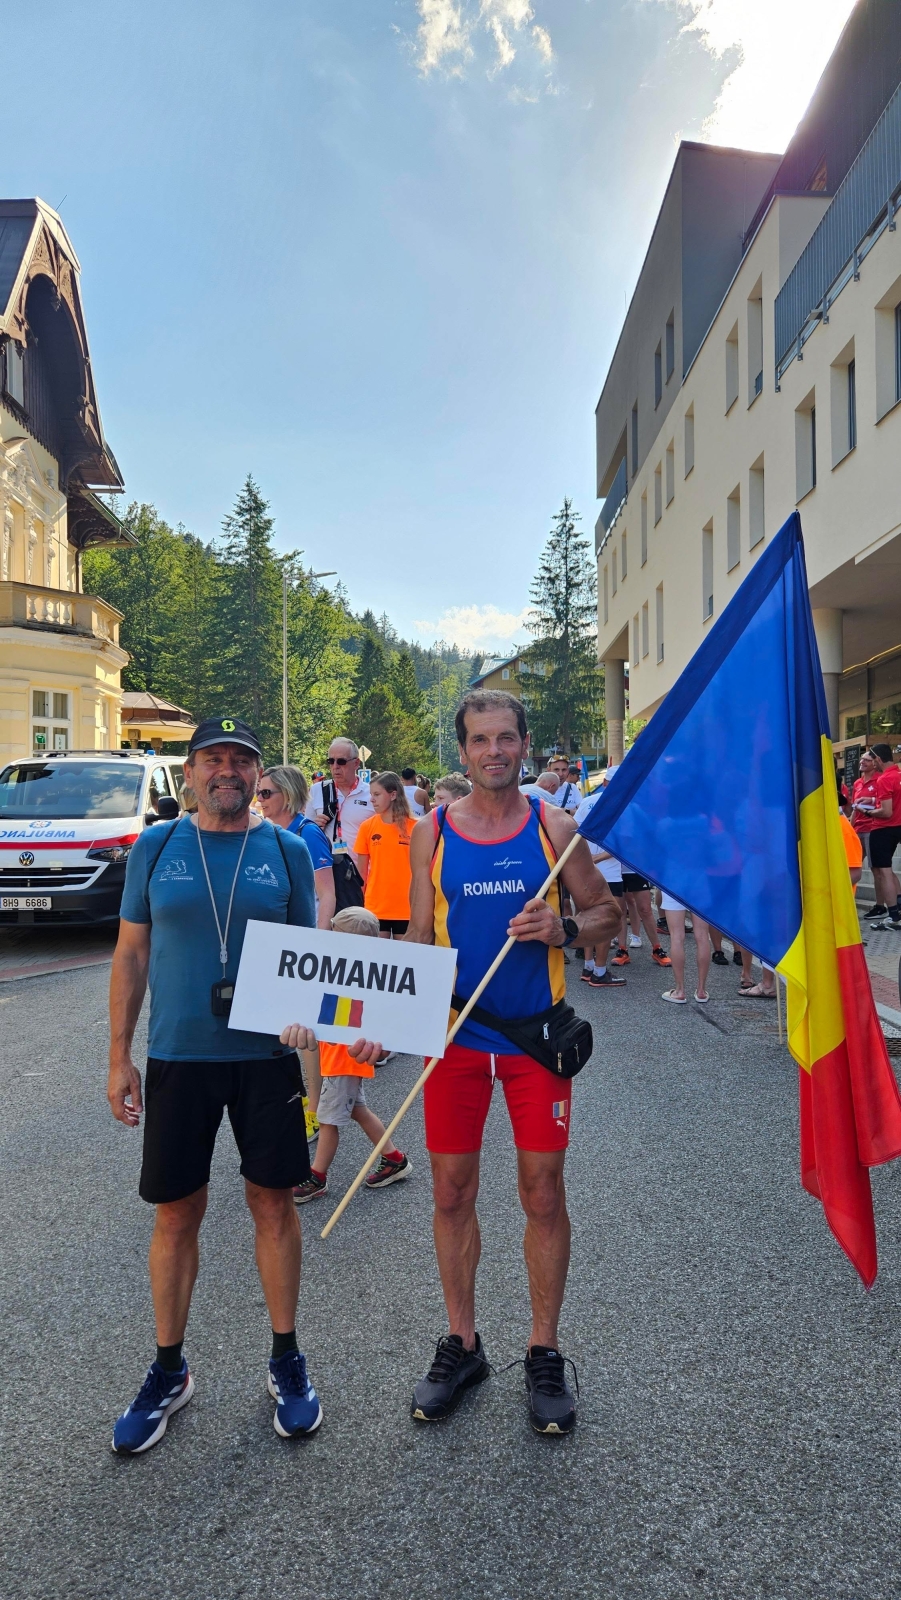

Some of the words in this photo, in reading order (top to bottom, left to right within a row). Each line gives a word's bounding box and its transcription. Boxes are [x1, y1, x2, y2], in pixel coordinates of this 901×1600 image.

[463, 879, 526, 896] ROMANIA
[3, 898, 19, 908] 8H9
[25, 898, 48, 908] 6686
[277, 949, 416, 996] ROMANIA
